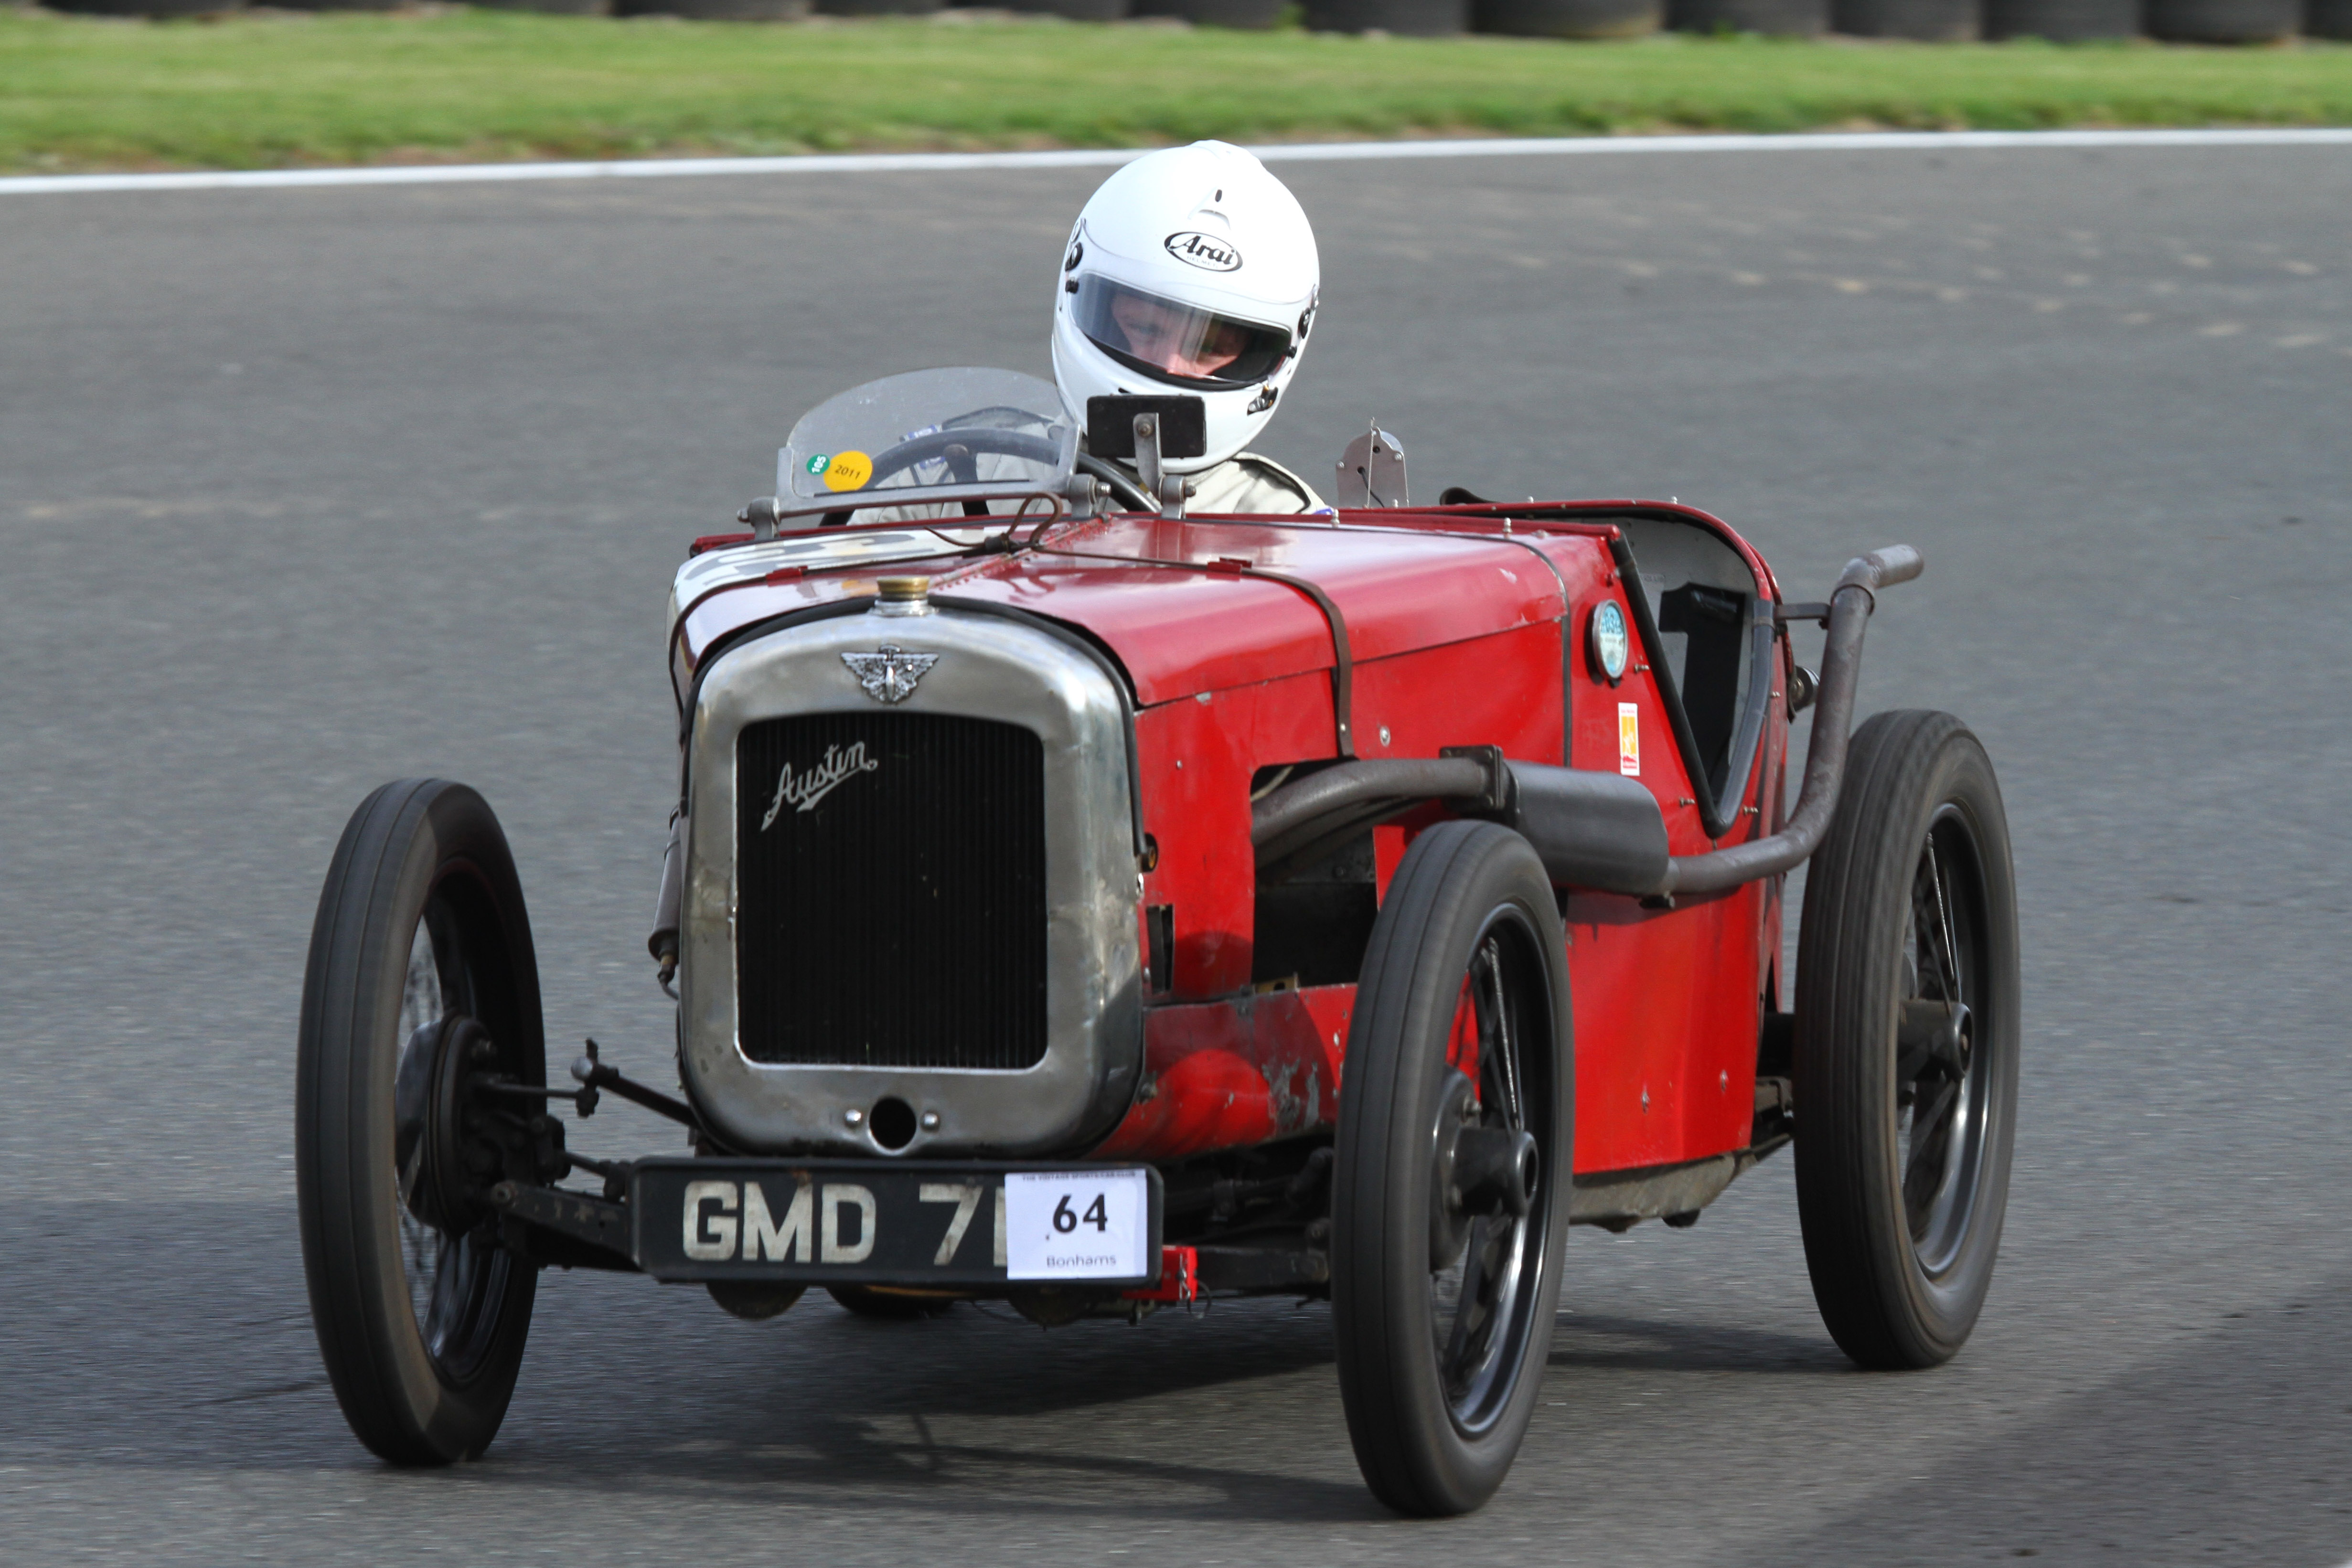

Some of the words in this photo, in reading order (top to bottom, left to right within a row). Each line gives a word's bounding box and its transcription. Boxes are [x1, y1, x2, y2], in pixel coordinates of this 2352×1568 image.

[1168, 234, 1236, 265] Arai
[811, 455, 827, 473] 105
[835, 464, 861, 480] 2011
[760, 740, 879, 832] Austin
[683, 1180, 877, 1264] GMD
[1052, 1193, 1108, 1234] 64
[1046, 1253, 1116, 1269] Bonhams
